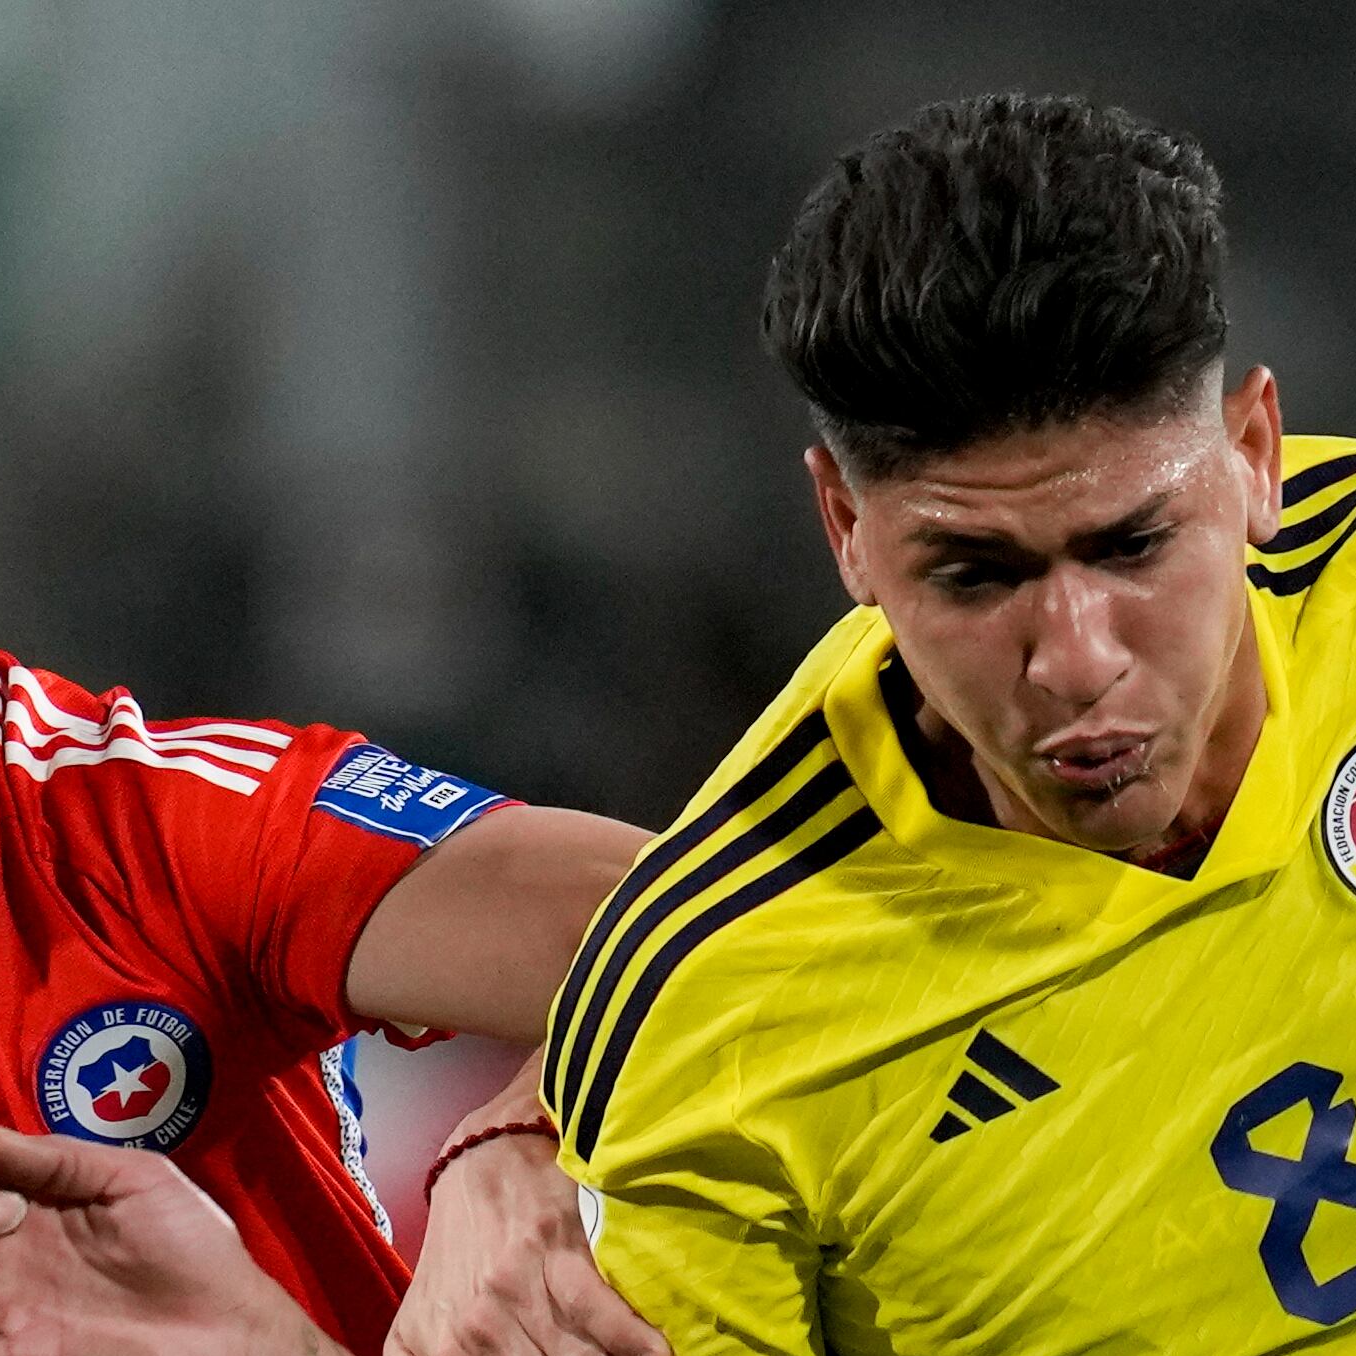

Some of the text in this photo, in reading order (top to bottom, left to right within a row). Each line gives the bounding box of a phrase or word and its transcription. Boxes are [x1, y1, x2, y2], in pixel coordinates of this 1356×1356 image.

[321, 750, 388, 790] FOOTBALL
[379, 787, 413, 812] the
[429, 787, 459, 805] FIFA
[1333, 784, 1354, 863] FEDERACION
[44, 1007, 193, 1123] FEDERACION DE FUTBOL
[155, 1102, 198, 1146] CHILE
